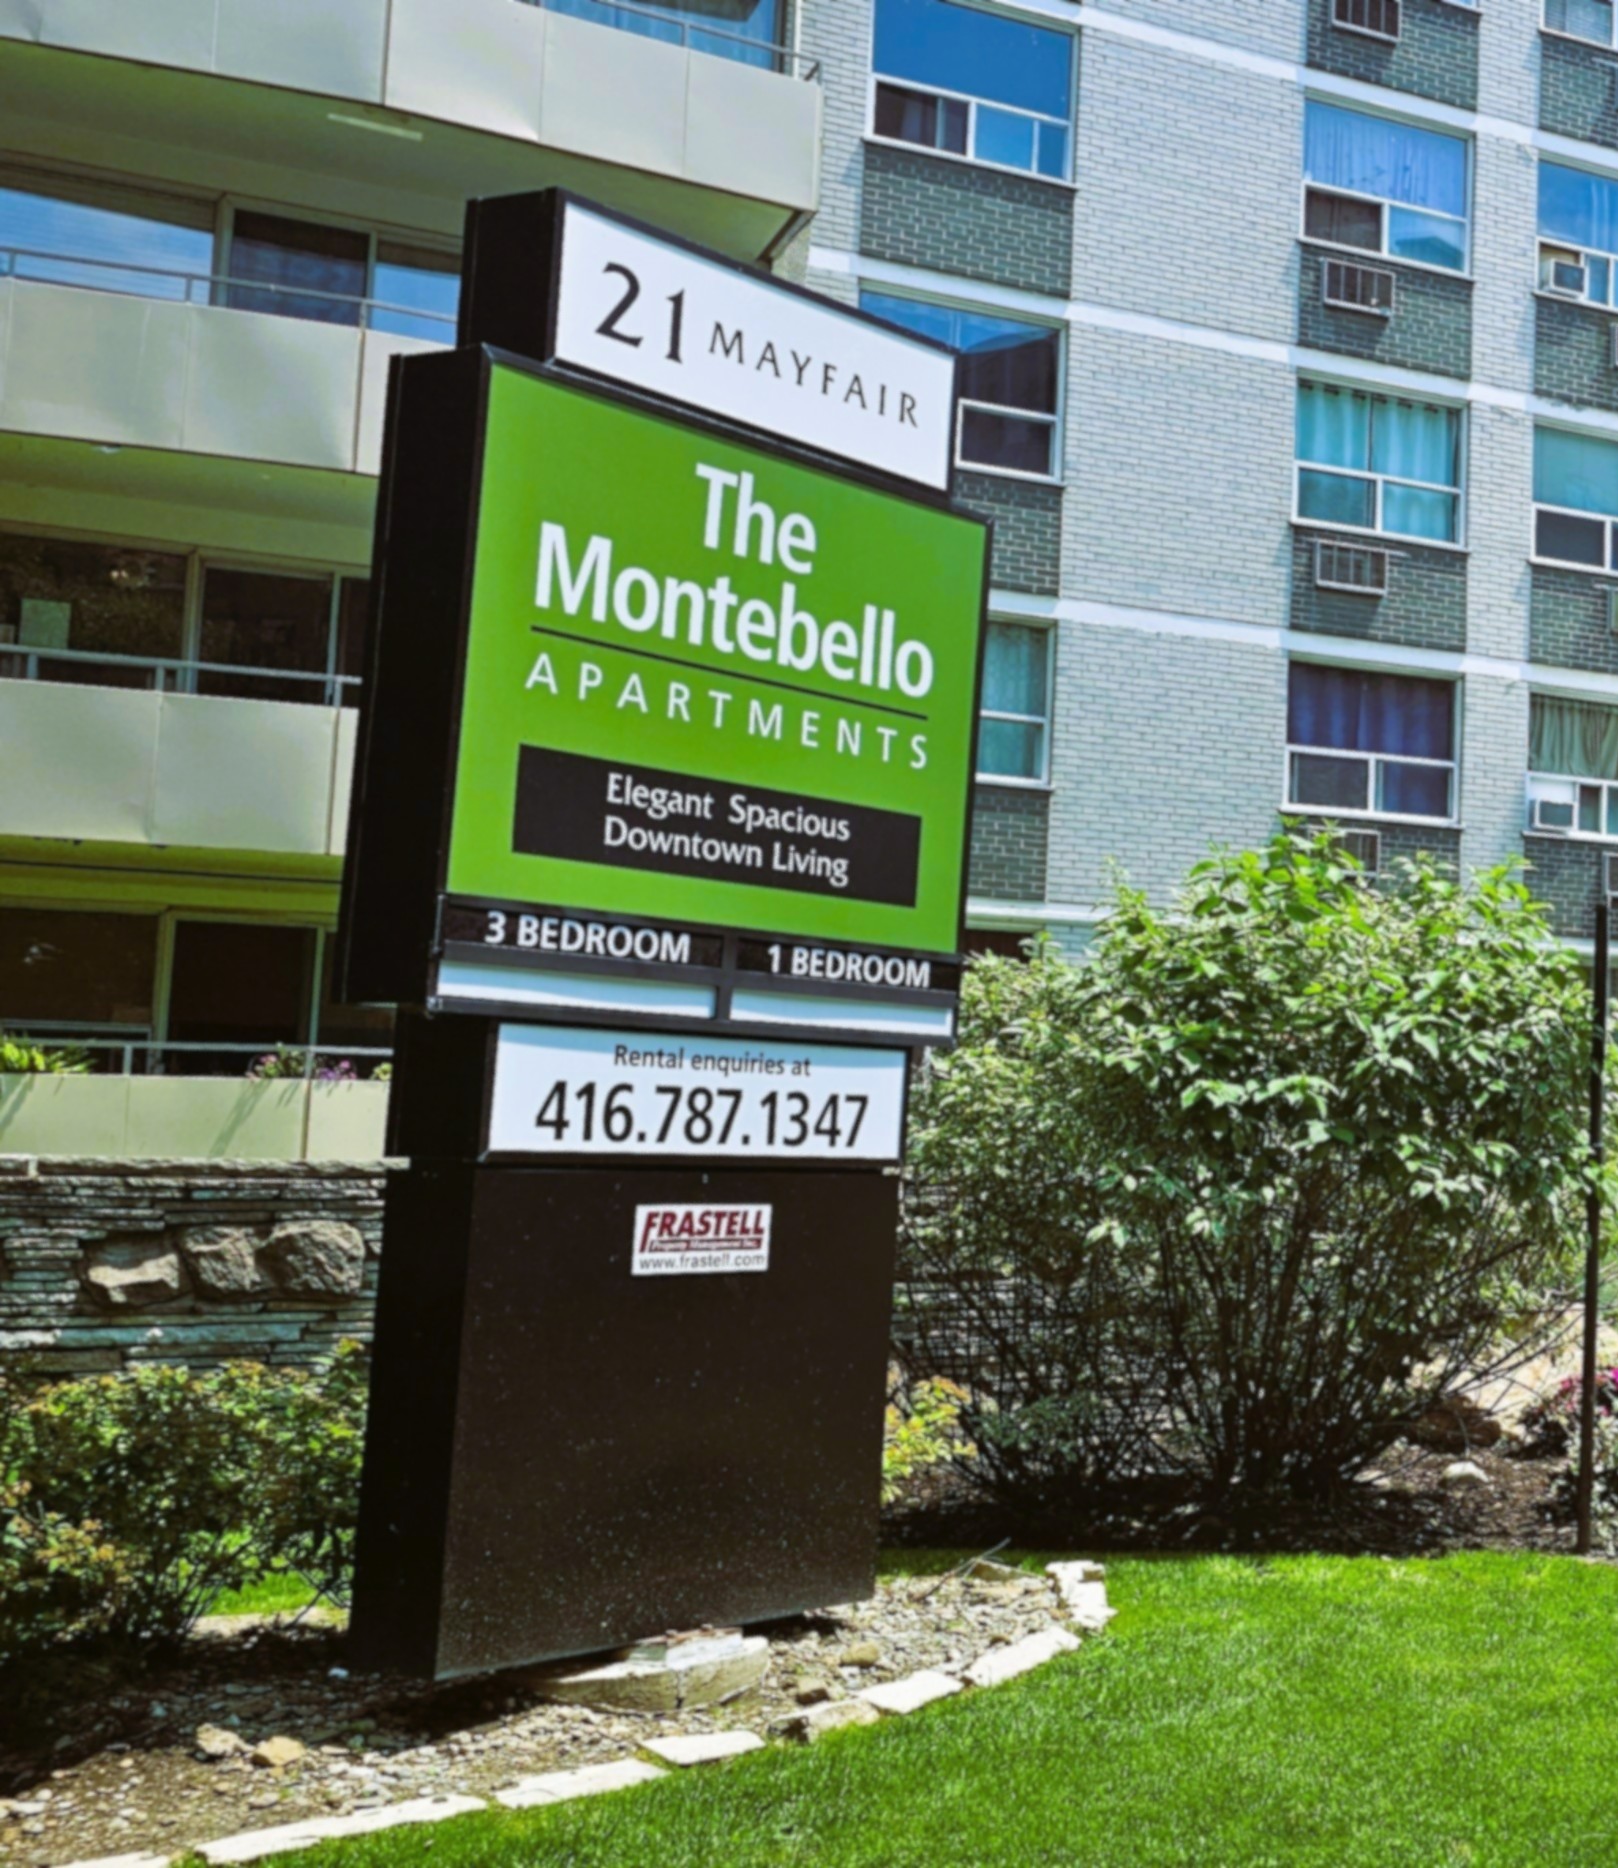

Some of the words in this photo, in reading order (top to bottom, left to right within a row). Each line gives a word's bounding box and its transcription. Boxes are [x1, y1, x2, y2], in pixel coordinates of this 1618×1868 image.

[594, 261, 686, 364] 21
[708, 321, 919, 428] MAYFAIR
[695, 462, 817, 574] The
[533, 520, 934, 698] Montebello
[525, 652, 929, 769] APARTMENTS
[605, 771, 714, 821] Elegant
[728, 793, 850, 843] Spacious
[602, 815, 763, 869] Downtown
[771, 843, 849, 888] Living
[484, 911, 507, 945] 3
[516, 915, 692, 965] BEDROOM
[767, 945, 780, 974] 1
[790, 947, 932, 990] BEDROOM
[613, 1044, 684, 1070] Rental
[691, 1053, 785, 1078] enquiries
[791, 1058, 811, 1077] at
[535, 1080, 869, 1149] 416.787.1347
[639, 1252, 766, 1270] www.frastell.com
[640, 1209, 765, 1253] FRASTELL
